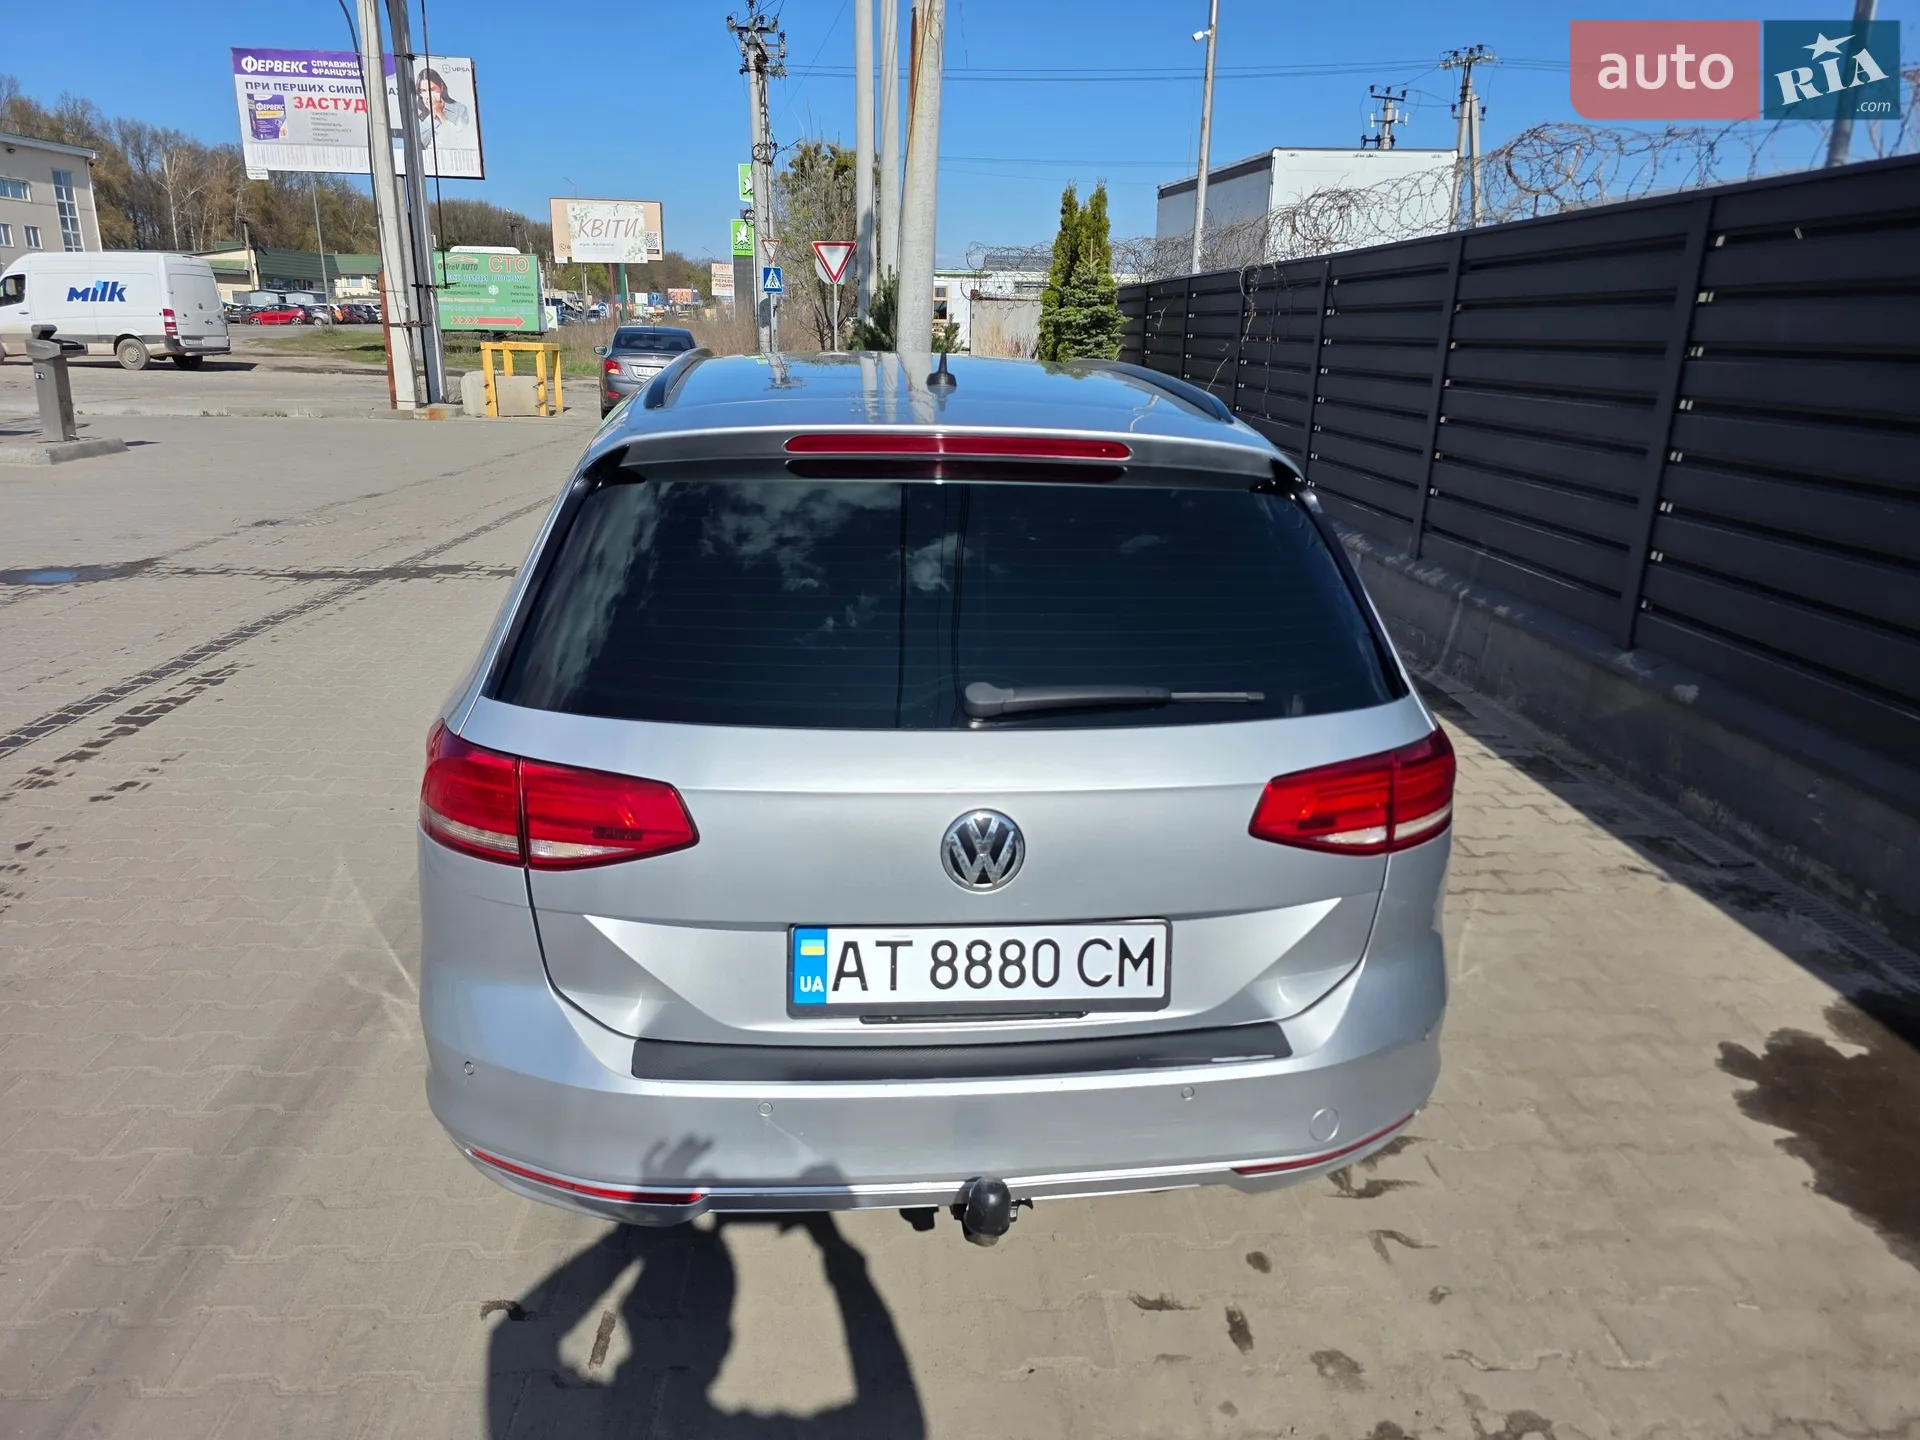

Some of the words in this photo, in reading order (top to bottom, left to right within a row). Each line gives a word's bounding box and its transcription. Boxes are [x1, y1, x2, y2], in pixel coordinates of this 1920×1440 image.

[241, 55, 308, 74] ФЕРВЕКС
[311, 60, 359, 69] СПРАВЖНІ
[245, 81, 270, 91] ПРИ
[273, 82, 325, 93] ПЕРШИХ
[293, 96, 368, 114] ЗАСТУД
[578, 218, 639, 239] КВІТИ
[460, 263, 479, 271] AUTO
[488, 255, 530, 274] СТО
[831, 939, 913, 992] AT
[929, 938, 1060, 990] 8880
[1077, 937, 1155, 988] CM
[799, 975, 824, 993] UA
